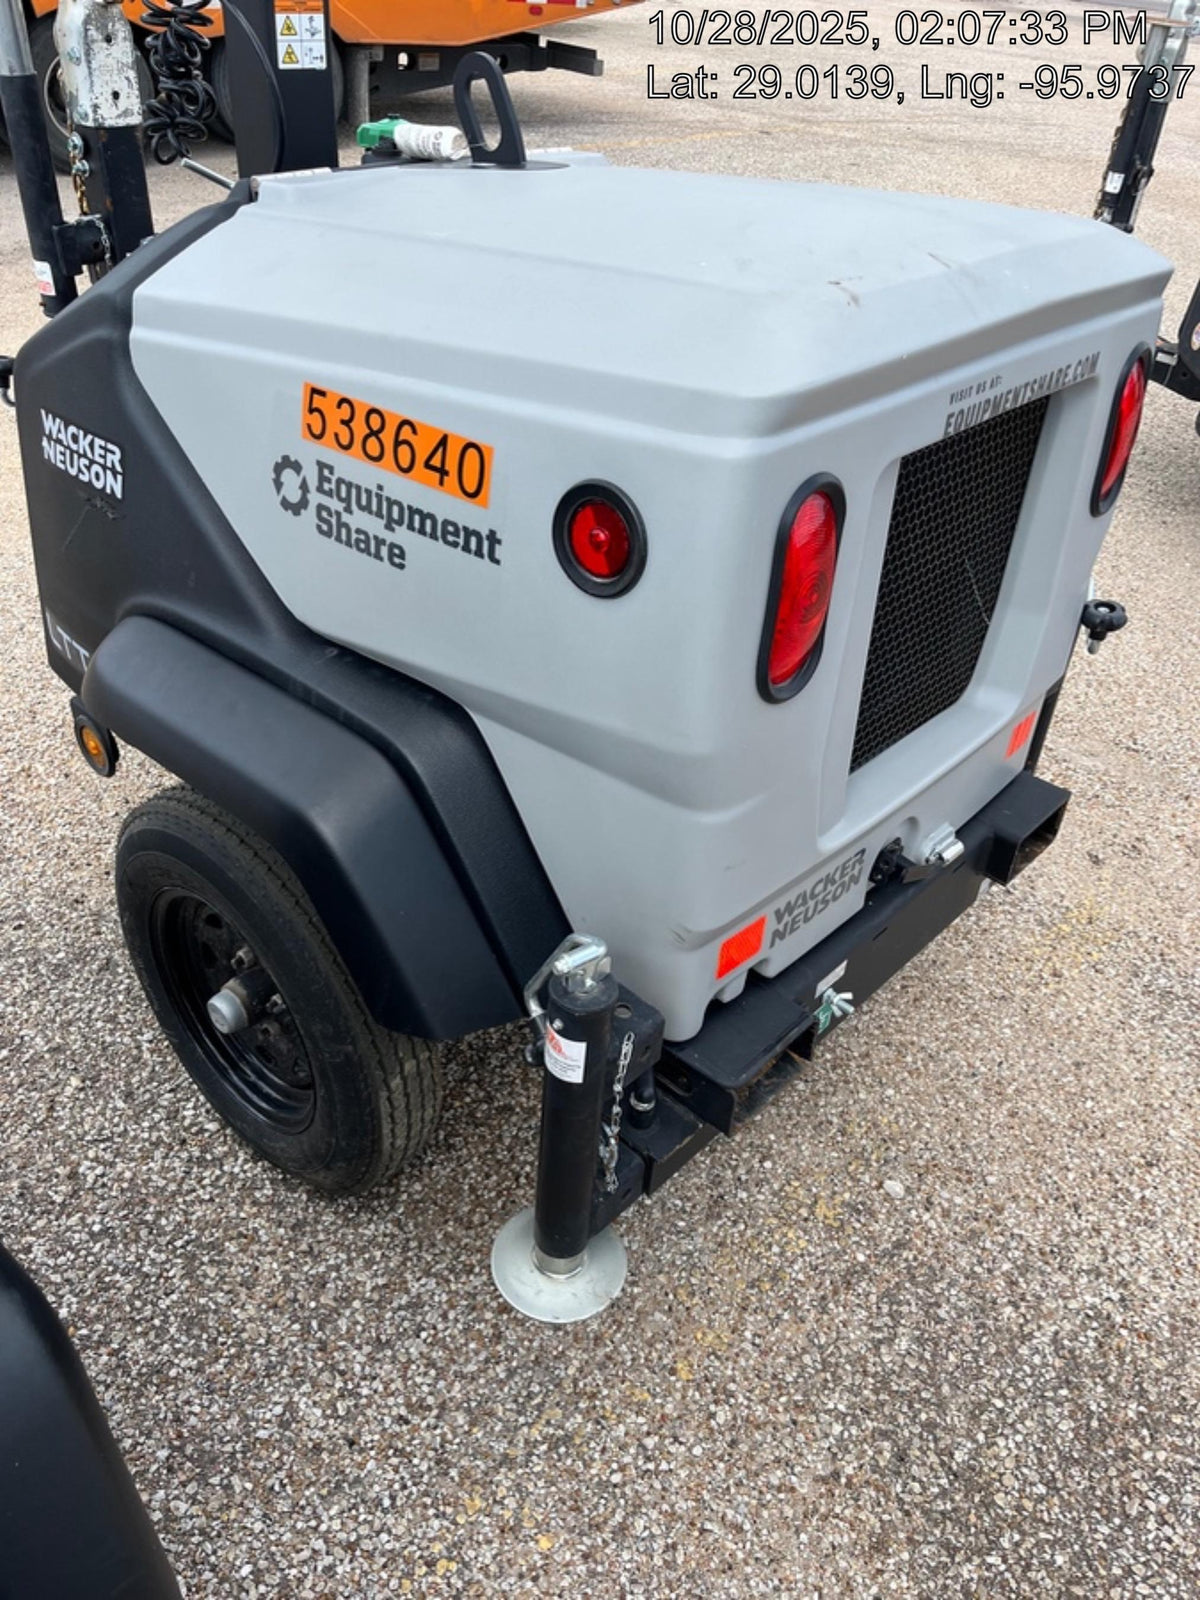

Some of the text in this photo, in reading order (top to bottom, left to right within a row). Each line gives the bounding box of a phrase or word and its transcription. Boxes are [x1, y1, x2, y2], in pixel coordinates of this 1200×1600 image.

[943, 351, 1101, 438] EQUIPMENTSHARE.COM
[949, 386, 974, 406] VISIT
[975, 379, 987, 396] US
[40, 407, 123, 473] WACKER
[42, 436, 123, 500] NEUSON
[305, 386, 486, 500] 538640
[315, 459, 502, 566] Equipment
[315, 502, 406, 571] Share
[769, 866, 863, 949] NEUSON
[774, 847, 866, 925] WACKER
